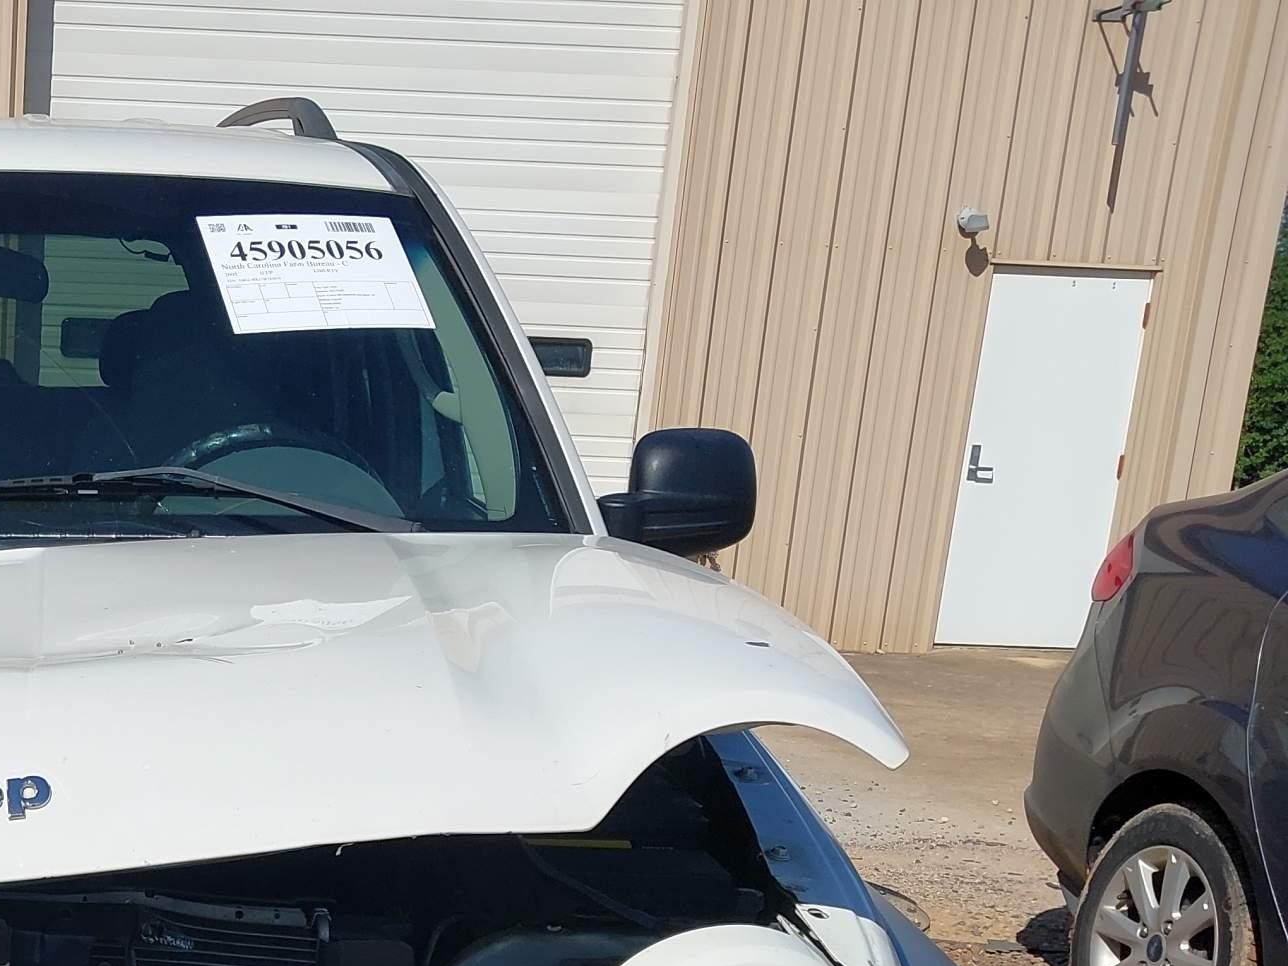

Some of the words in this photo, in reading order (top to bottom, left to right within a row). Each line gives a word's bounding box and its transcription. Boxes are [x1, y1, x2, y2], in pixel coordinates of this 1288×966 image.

[230, 239, 383, 261] 45905056
[221, 262, 245, 270] North
[247, 261, 282, 269] Carolina
